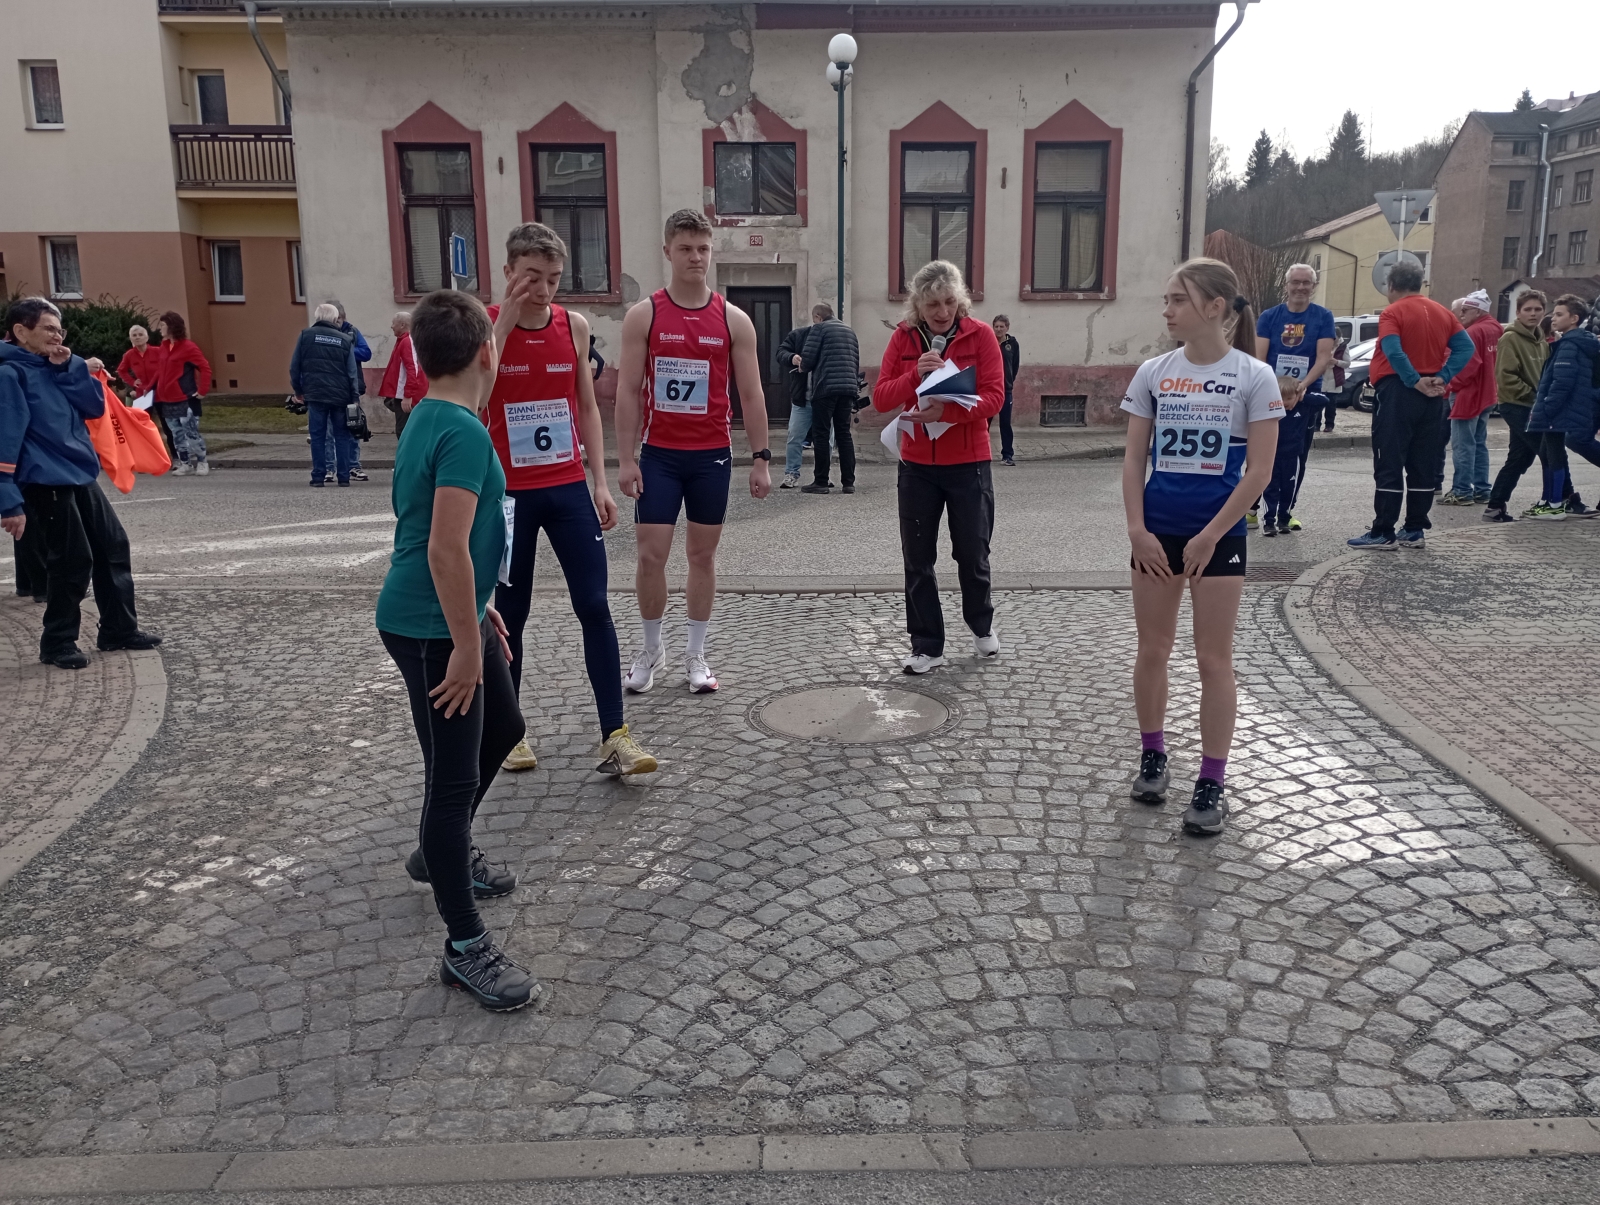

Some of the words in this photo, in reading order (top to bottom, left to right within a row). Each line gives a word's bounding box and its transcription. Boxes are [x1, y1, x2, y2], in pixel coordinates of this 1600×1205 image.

[500, 364, 530, 373] Krakonoš
[656, 366, 689, 374] BĚŽECKÁ
[1283, 366, 1300, 378] 79
[666, 379, 696, 402] 67
[1159, 378, 1236, 396] OlfinCar
[507, 404, 536, 415] ZIMNÍ
[1160, 402, 1190, 412] ZIMNÍ
[508, 413, 550, 422] BĚŽECKÁ
[534, 426, 552, 452] 6
[1161, 428, 1222, 458] 259
